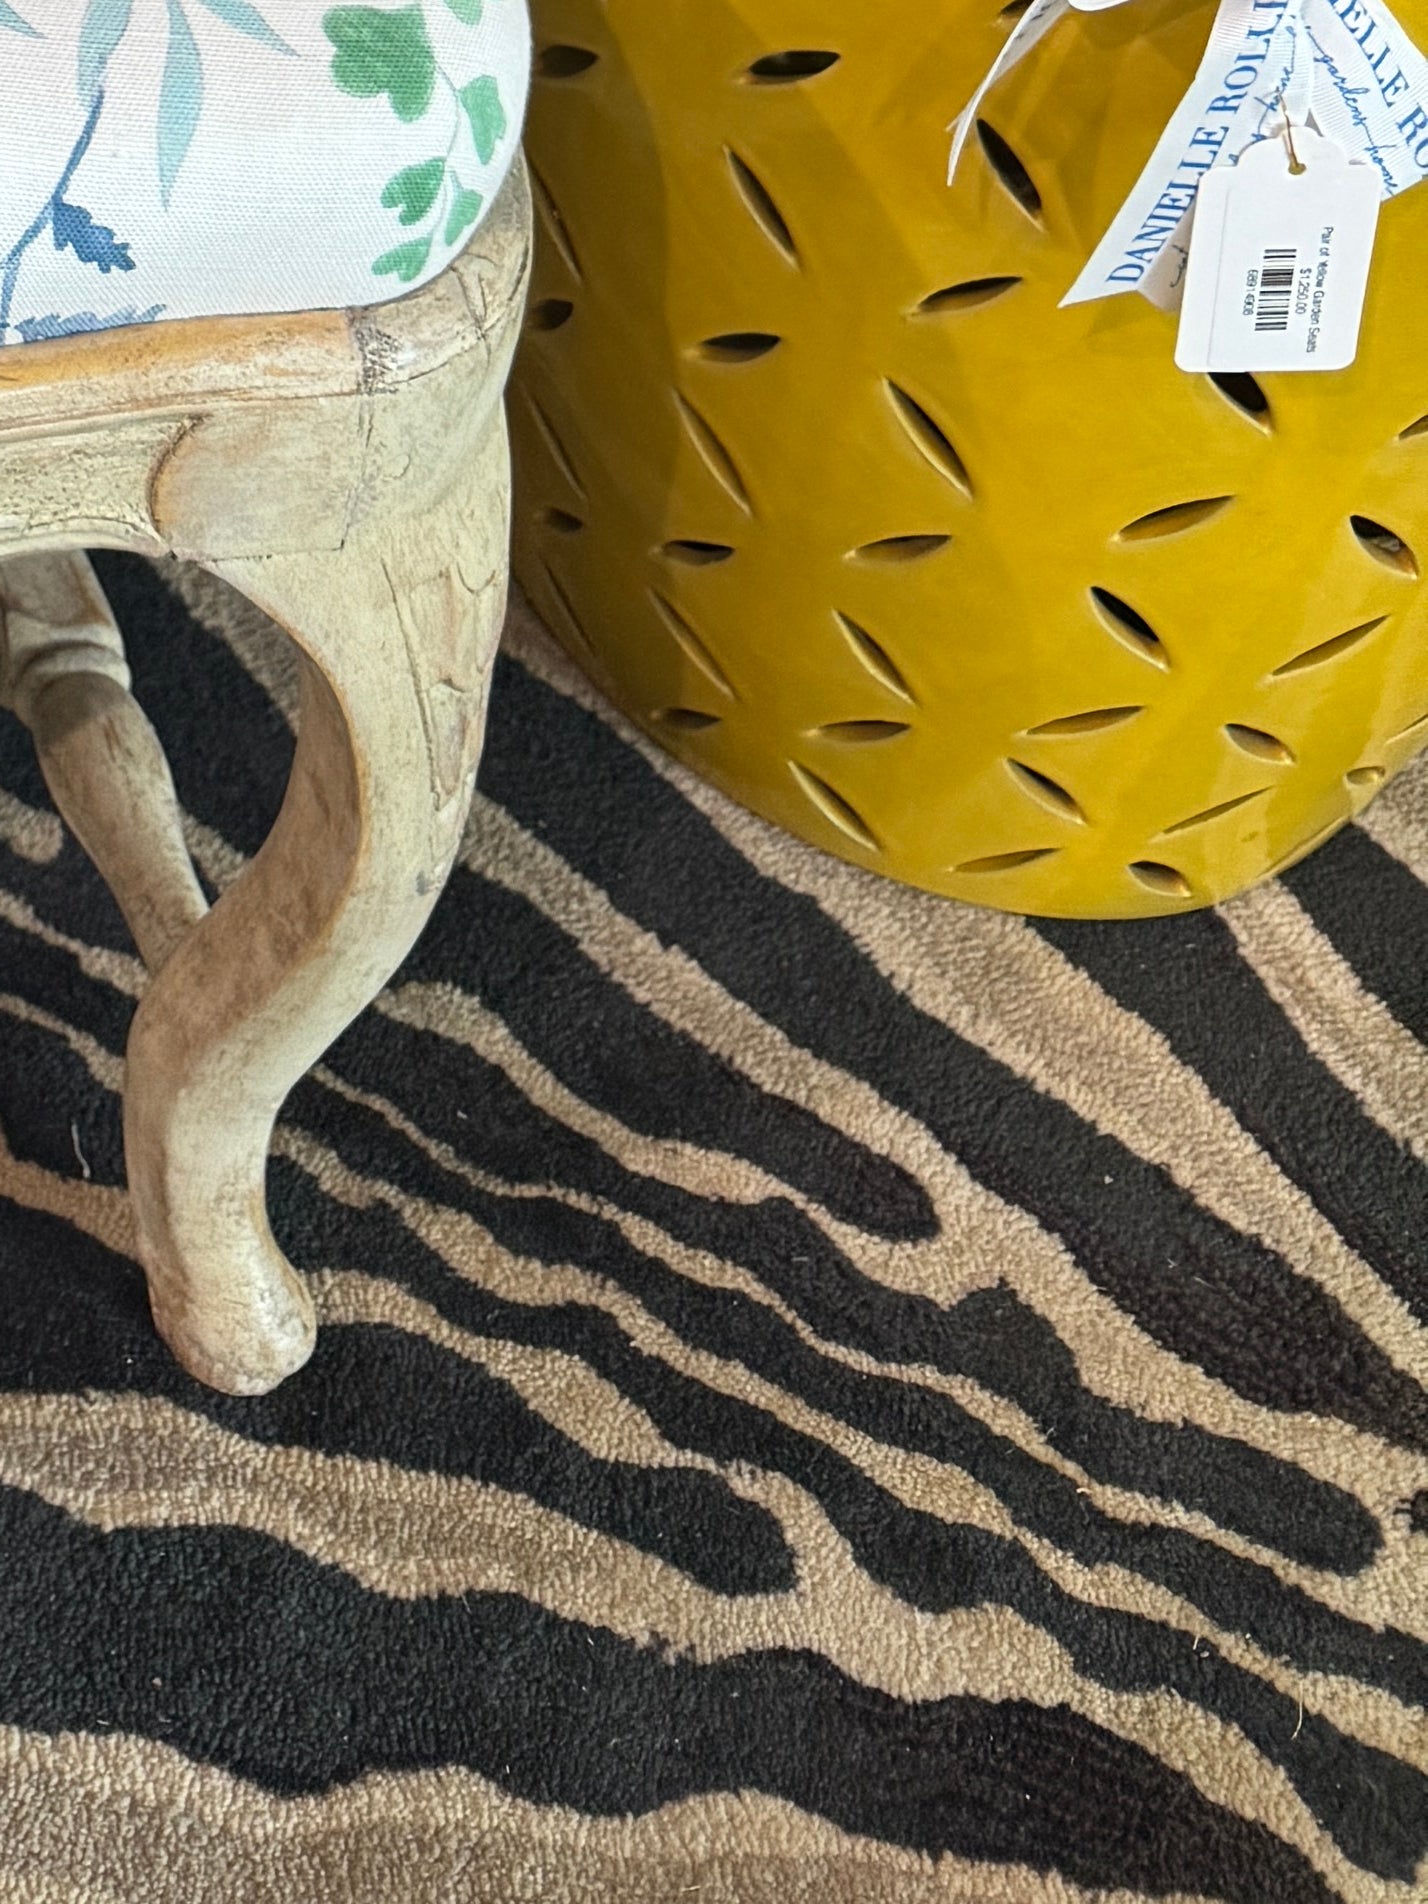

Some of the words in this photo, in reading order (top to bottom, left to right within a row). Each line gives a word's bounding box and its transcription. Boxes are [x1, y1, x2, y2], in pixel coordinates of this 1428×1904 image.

[1313, 46, 1370, 127] gardens
[1106, 126, 1229, 284] DANIELLE
[1321, 226, 1334, 245] Pair
[1319, 247, 1330, 257] of
[1315, 260, 1329, 289] Yellow
[1242, 269, 1259, 316] 68914908
[1311, 290, 1325, 325] Garden
[1306, 327, 1321, 353] Seats
